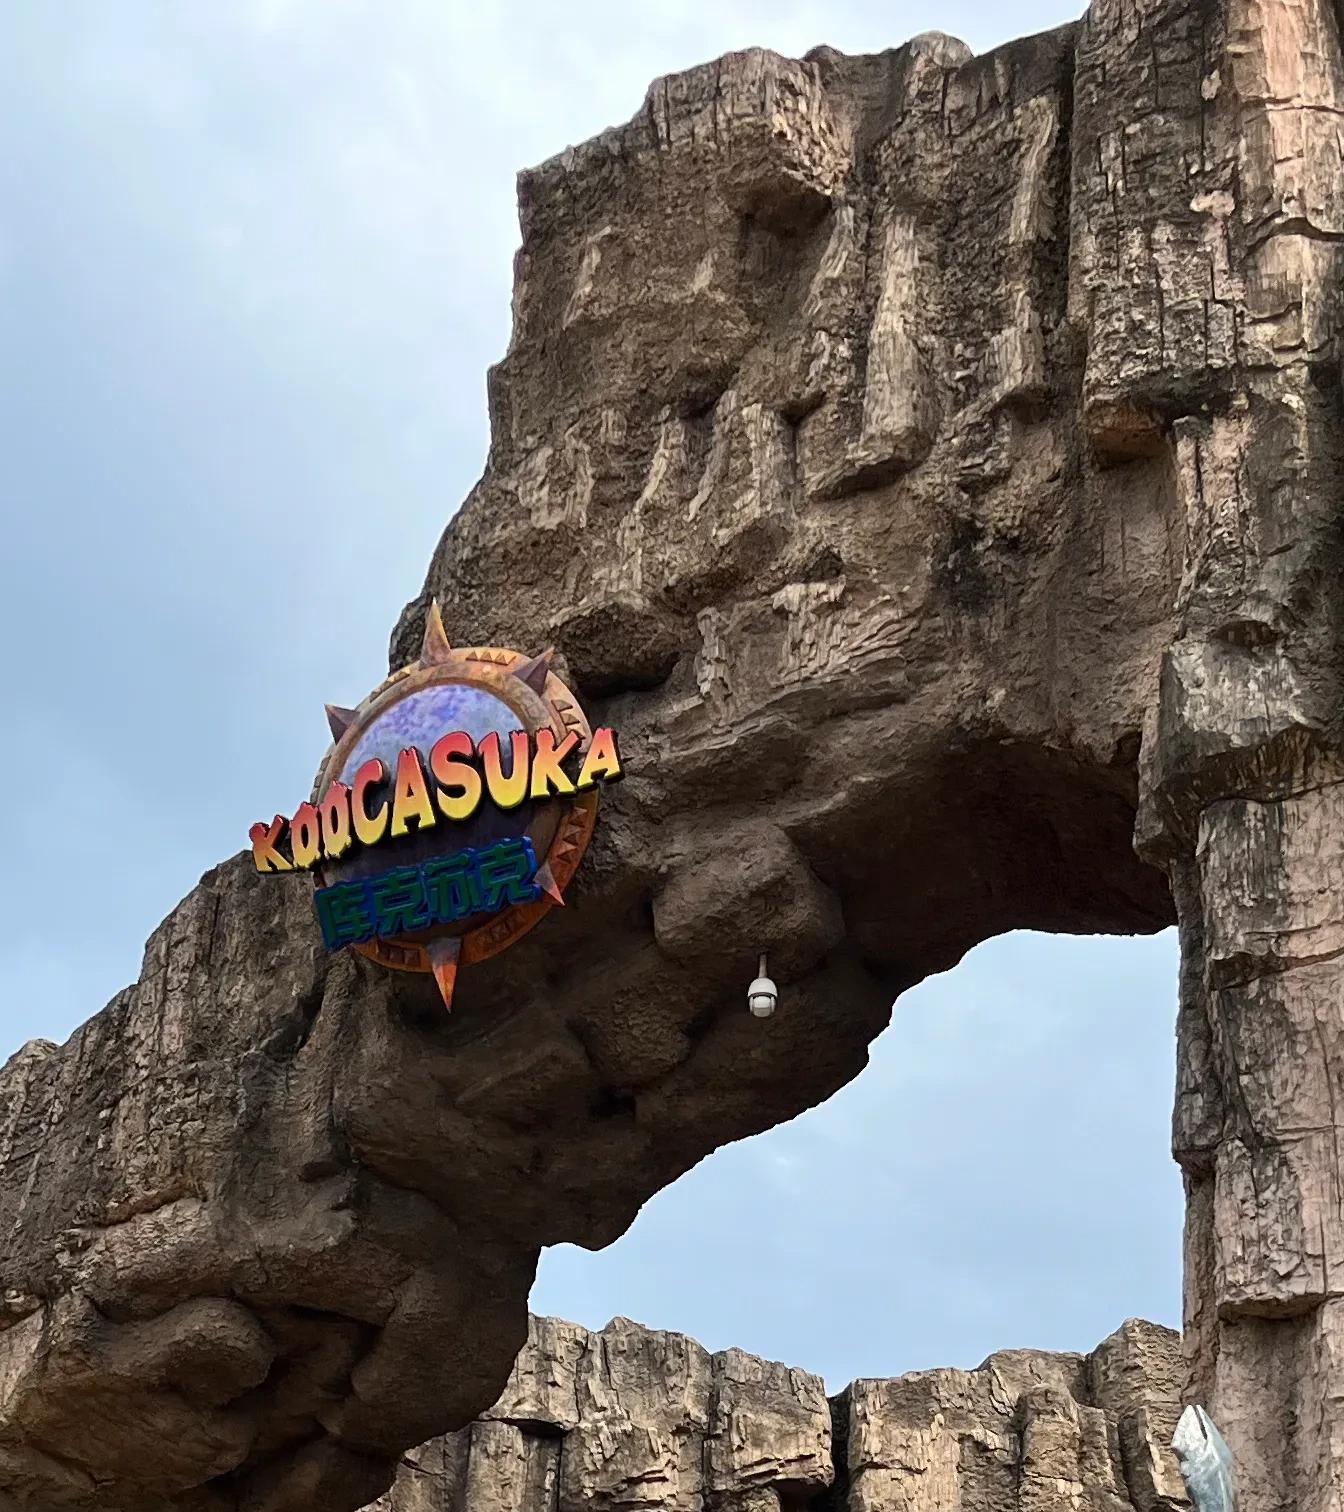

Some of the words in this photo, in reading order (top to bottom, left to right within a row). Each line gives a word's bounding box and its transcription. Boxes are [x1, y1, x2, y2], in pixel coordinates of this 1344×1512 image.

[248, 727, 626, 875] KOOCASUKA
[315, 837, 541, 950] 库克苏克
